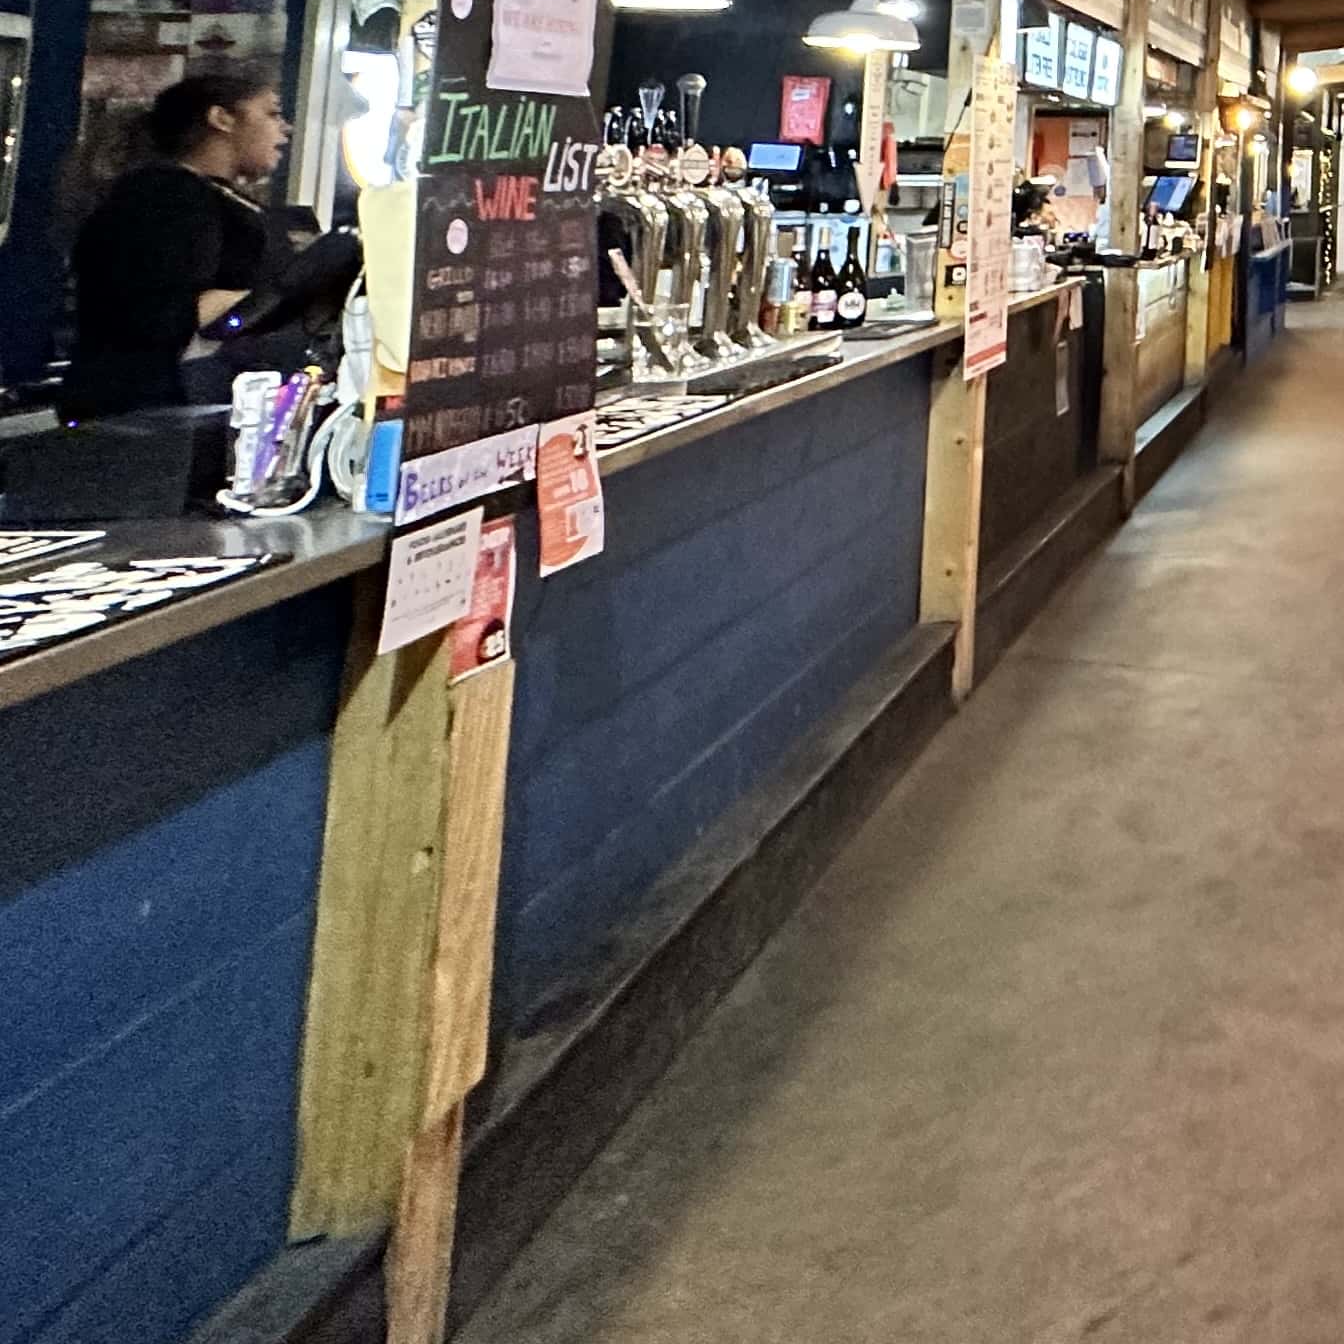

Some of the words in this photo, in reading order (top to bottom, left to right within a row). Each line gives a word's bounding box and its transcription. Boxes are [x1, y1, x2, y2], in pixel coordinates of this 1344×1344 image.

[428, 91, 557, 165] ITALIAN
[543, 136, 599, 193] LIST
[474, 174, 540, 221] WINE
